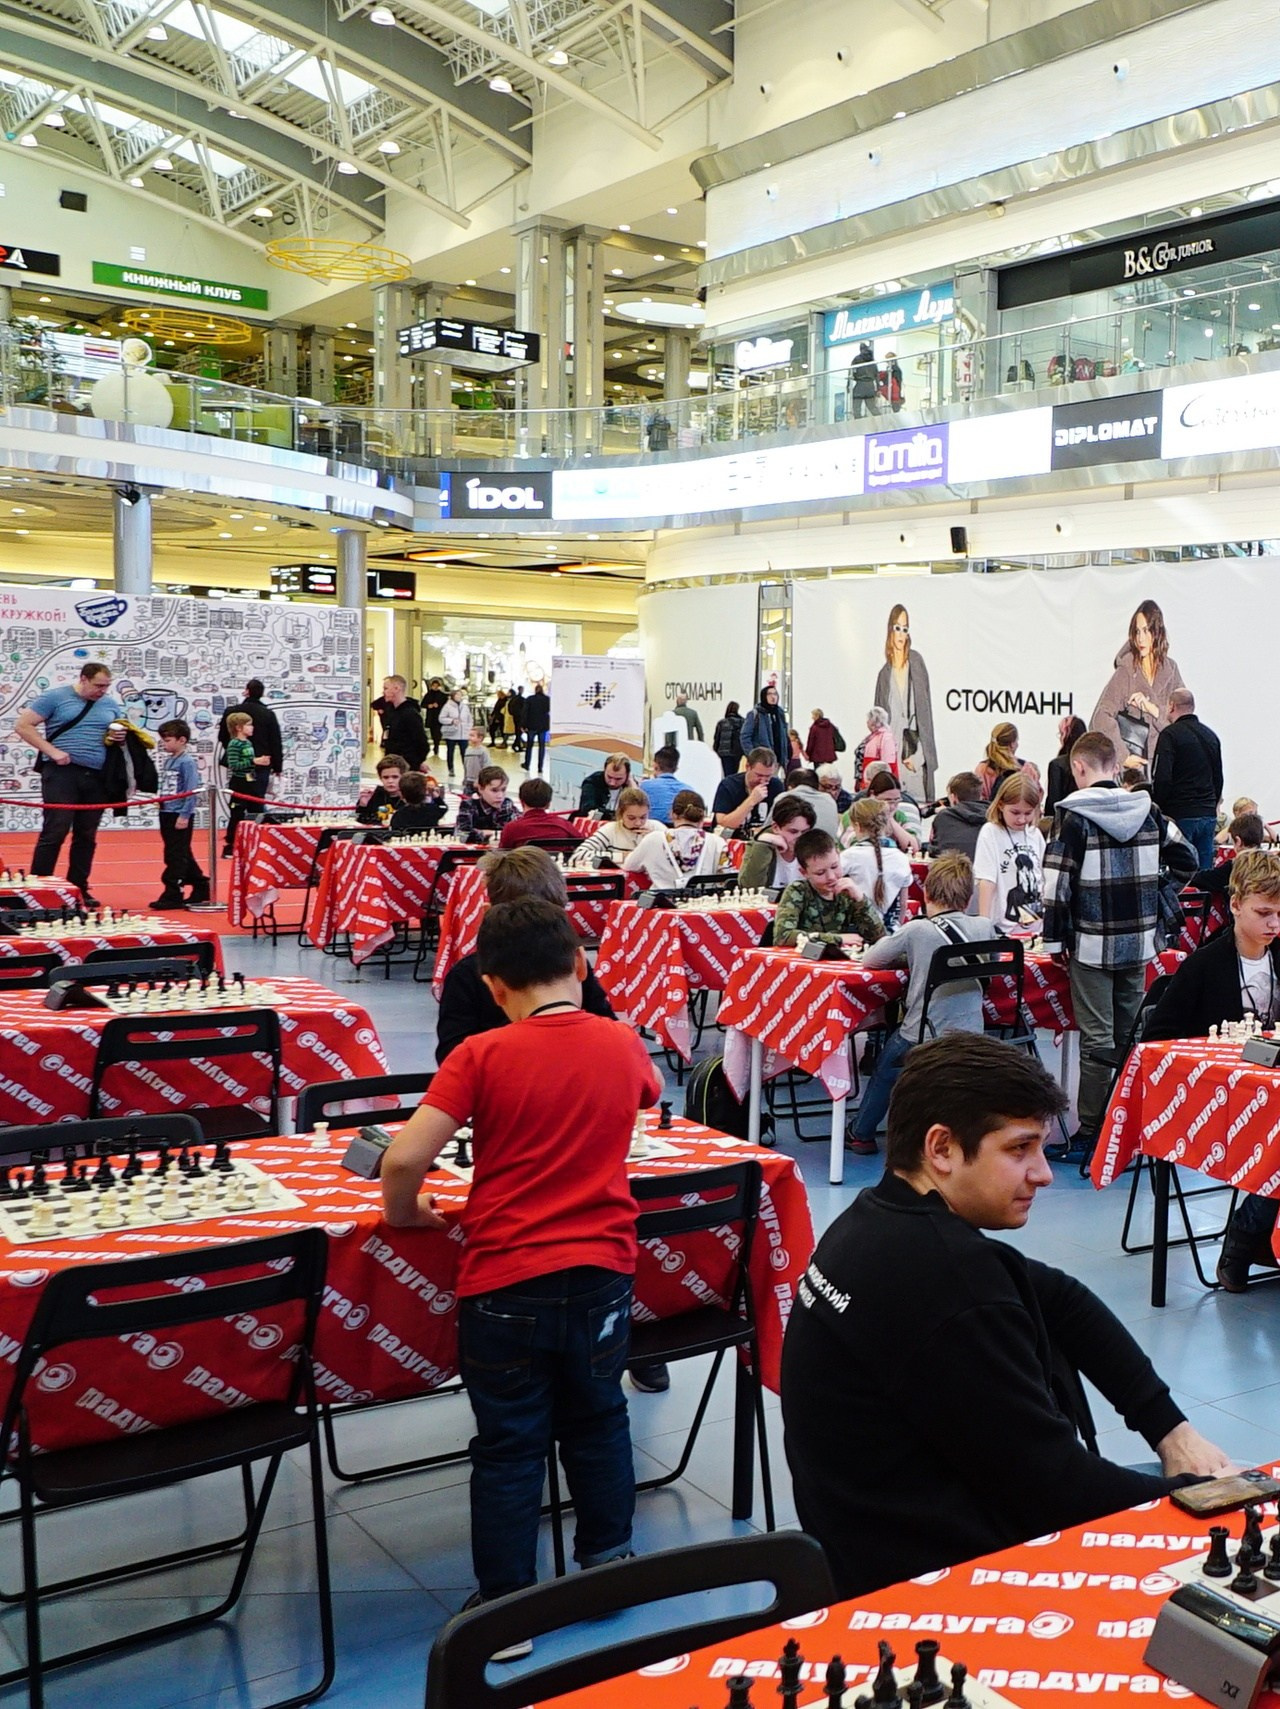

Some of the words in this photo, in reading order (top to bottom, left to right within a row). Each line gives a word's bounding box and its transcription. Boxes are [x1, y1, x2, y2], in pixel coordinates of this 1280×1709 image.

[1177, 239, 1214, 261] JUNIOR
[122, 271, 201, 295] КНИЖНЫЙ
[204, 285, 242, 301] КЛУБ
[1055, 416, 1158, 447] DIPLOMAT
[1, 608, 67, 623] КРУЖКОЙ!
[665, 681, 722, 701] СТОКМАНН
[946, 689, 1073, 716] СТОКМАНН
[1143, 1099, 1180, 1141] радуга
[1186, 1100, 1220, 1143] радуга
[1227, 1101, 1262, 1146] радуга
[360, 1234, 435, 1305] радуга
[366, 1323, 437, 1385] радуга
[970, 1568, 1141, 1591] радуга
[848, 1611, 1029, 1635] радуга
[975, 1667, 1162, 1694] радуга
